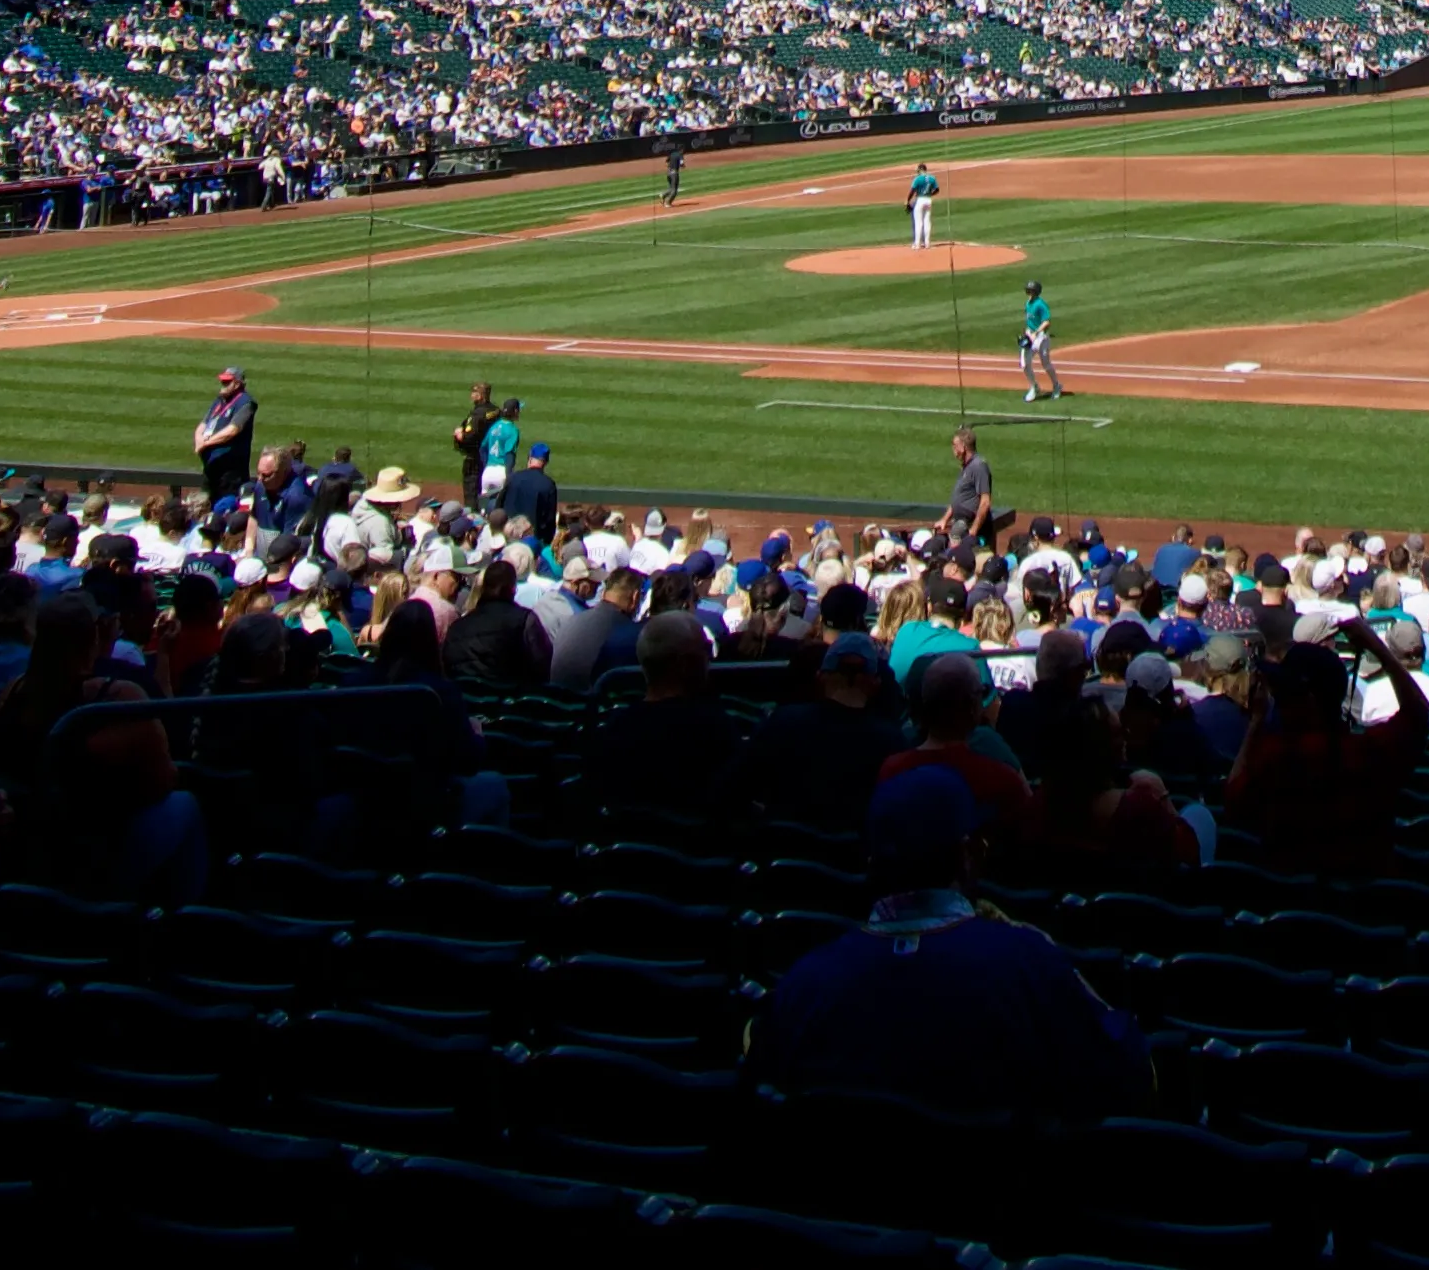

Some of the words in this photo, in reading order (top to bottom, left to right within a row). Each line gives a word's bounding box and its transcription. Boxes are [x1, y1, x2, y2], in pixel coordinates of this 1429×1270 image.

[819, 120, 870, 134] LEXUS
[939, 111, 969, 126] Great
[971, 110, 996, 127] Clips
[489, 439, 499, 456] 4
